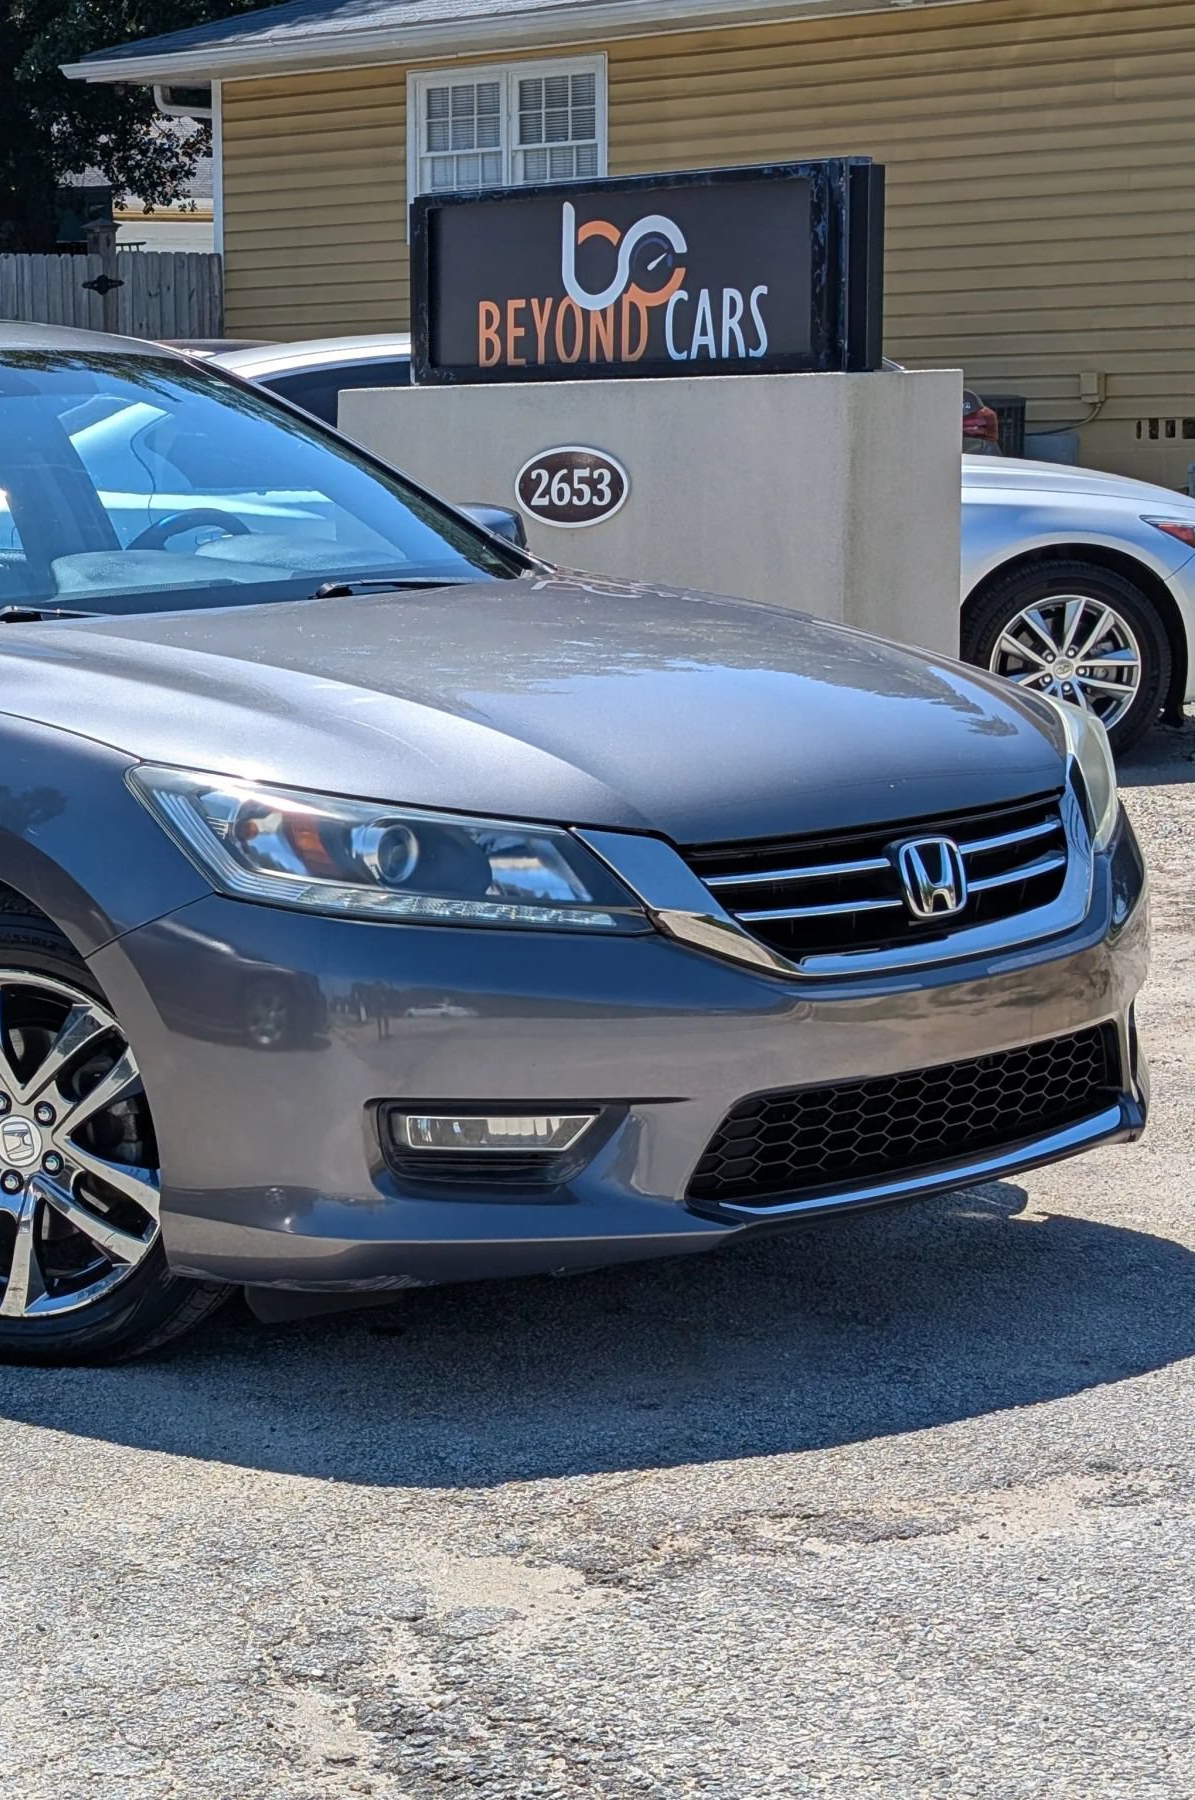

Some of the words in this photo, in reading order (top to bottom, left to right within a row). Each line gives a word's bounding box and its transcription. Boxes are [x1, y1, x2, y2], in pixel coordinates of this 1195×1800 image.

[478, 297, 648, 367] BEYOND
[665, 285, 768, 361] CARS
[530, 468, 612, 506] 2653
